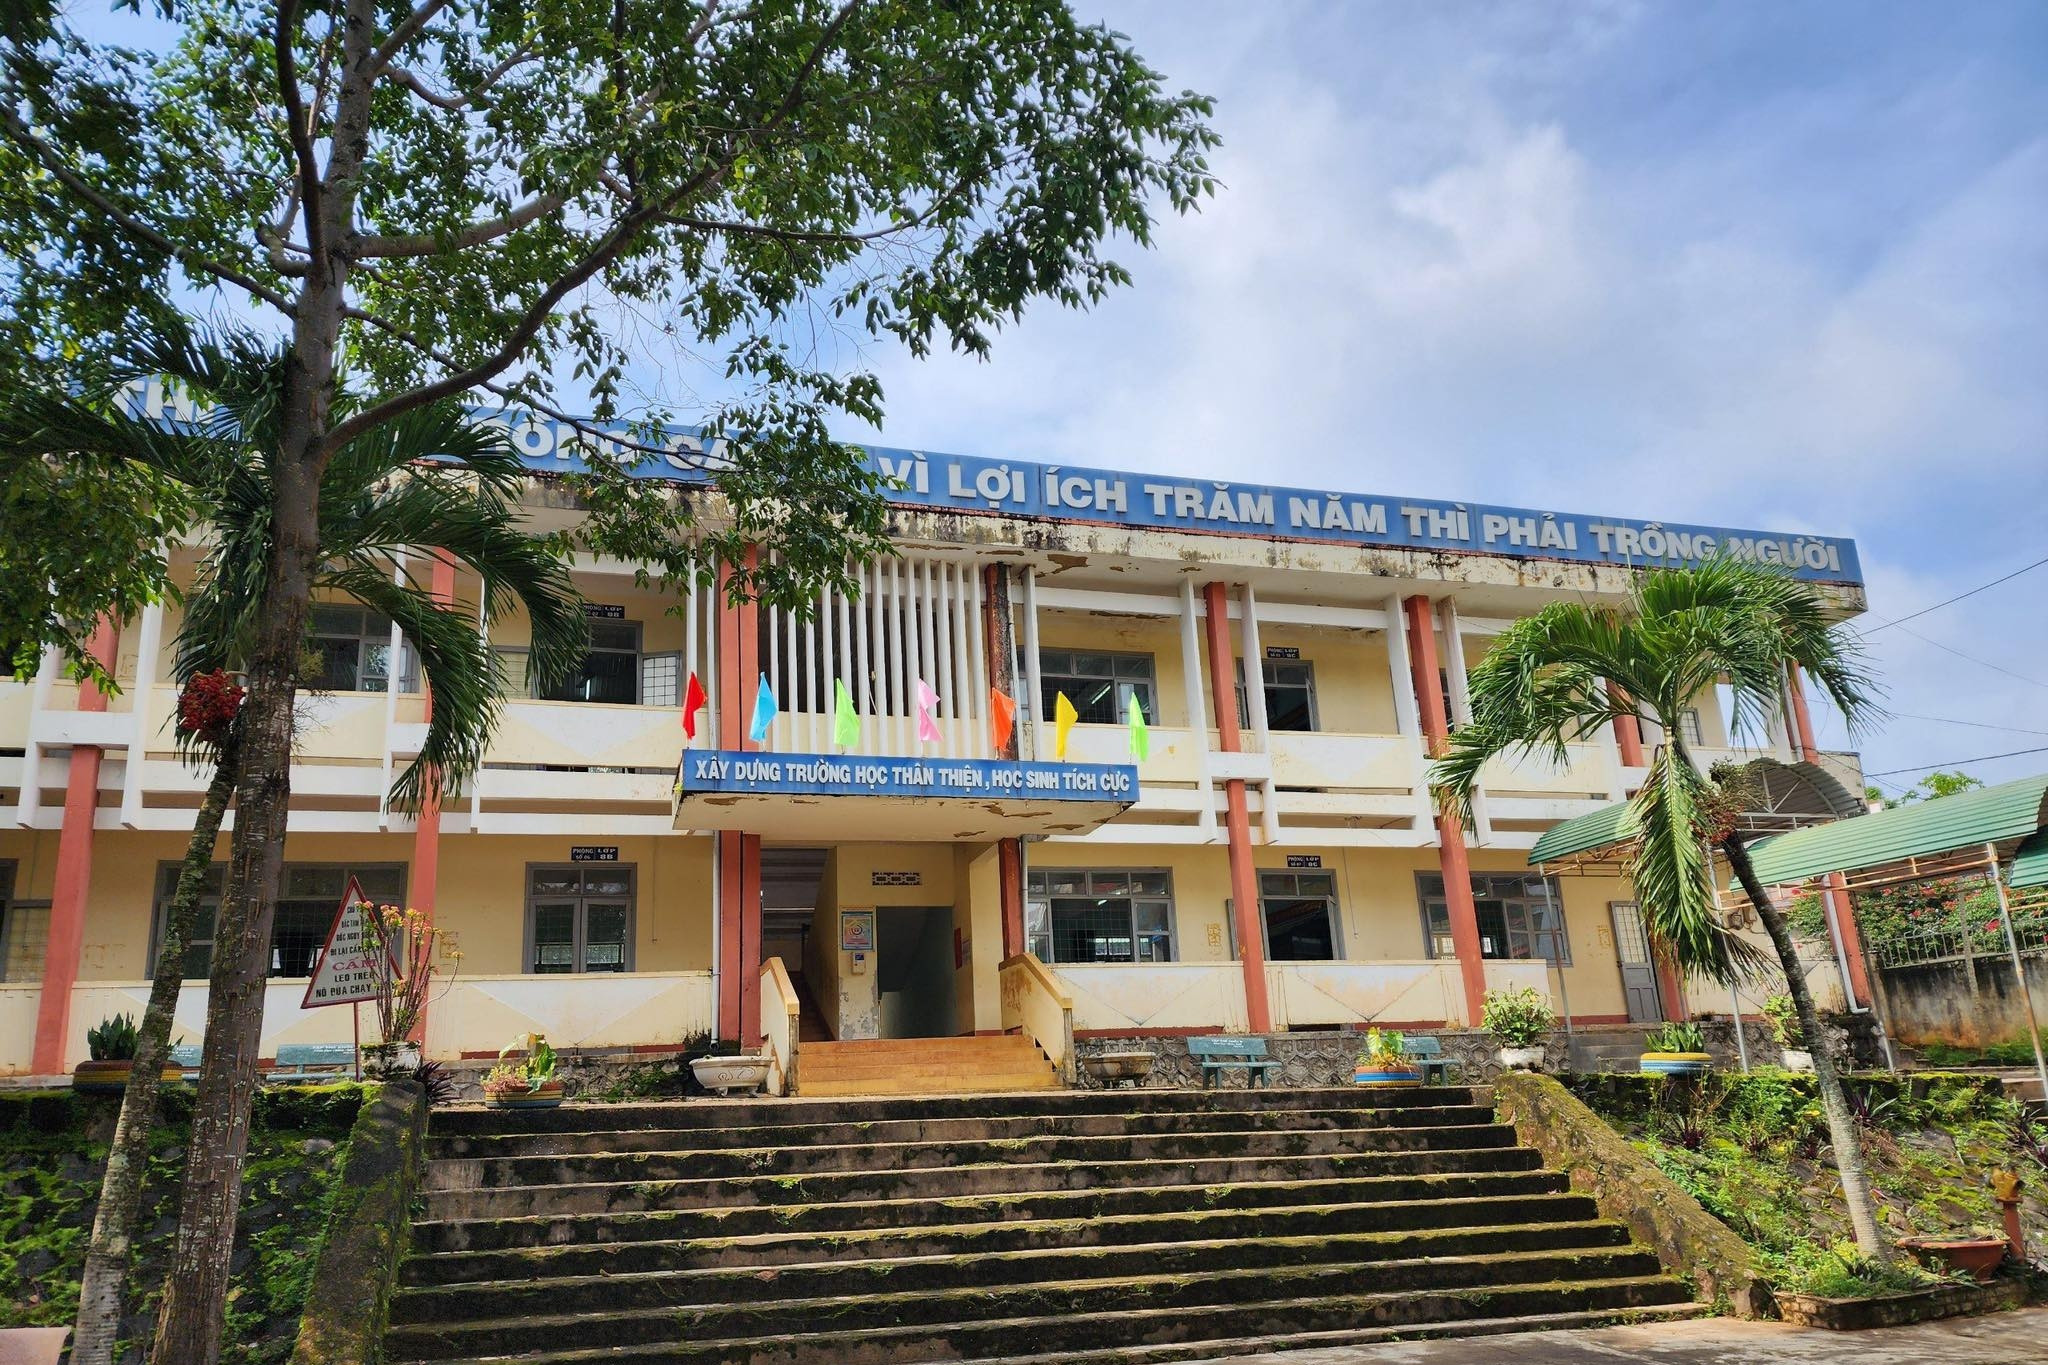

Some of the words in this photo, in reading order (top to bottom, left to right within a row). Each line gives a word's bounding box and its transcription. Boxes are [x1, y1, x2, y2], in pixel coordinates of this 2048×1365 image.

[877, 450, 929, 494] VÌ
[948, 463, 1025, 509] LỢI
[1045, 466, 1127, 513] ÍCH
[1144, 481, 1275, 525] TRĂM
[1289, 493, 1387, 534] NĂM
[1401, 503, 1470, 541] THÌ
[1482, 512, 1577, 551] PHẢI
[1588, 521, 1716, 562] TRỒNG
[1726, 536, 1841, 572] NGƯỜI
[695, 756, 729, 780] XÂY
[735, 758, 781, 787] DỰNG
[785, 758, 851, 784] TRƯỜNG
[855, 765, 888, 789] HỌC
[892, 763, 934, 785] THÂN
[993, 769, 1022, 793] HỌC
[1026, 770, 1060, 789] SINH
[1062, 768, 1096, 790] TÍCH
[1101, 770, 1130, 796] CỰC
[332, 957, 378, 971] CẤM
[334, 973, 350, 982] LEO
[350, 984, 371, 994] CHẠY
